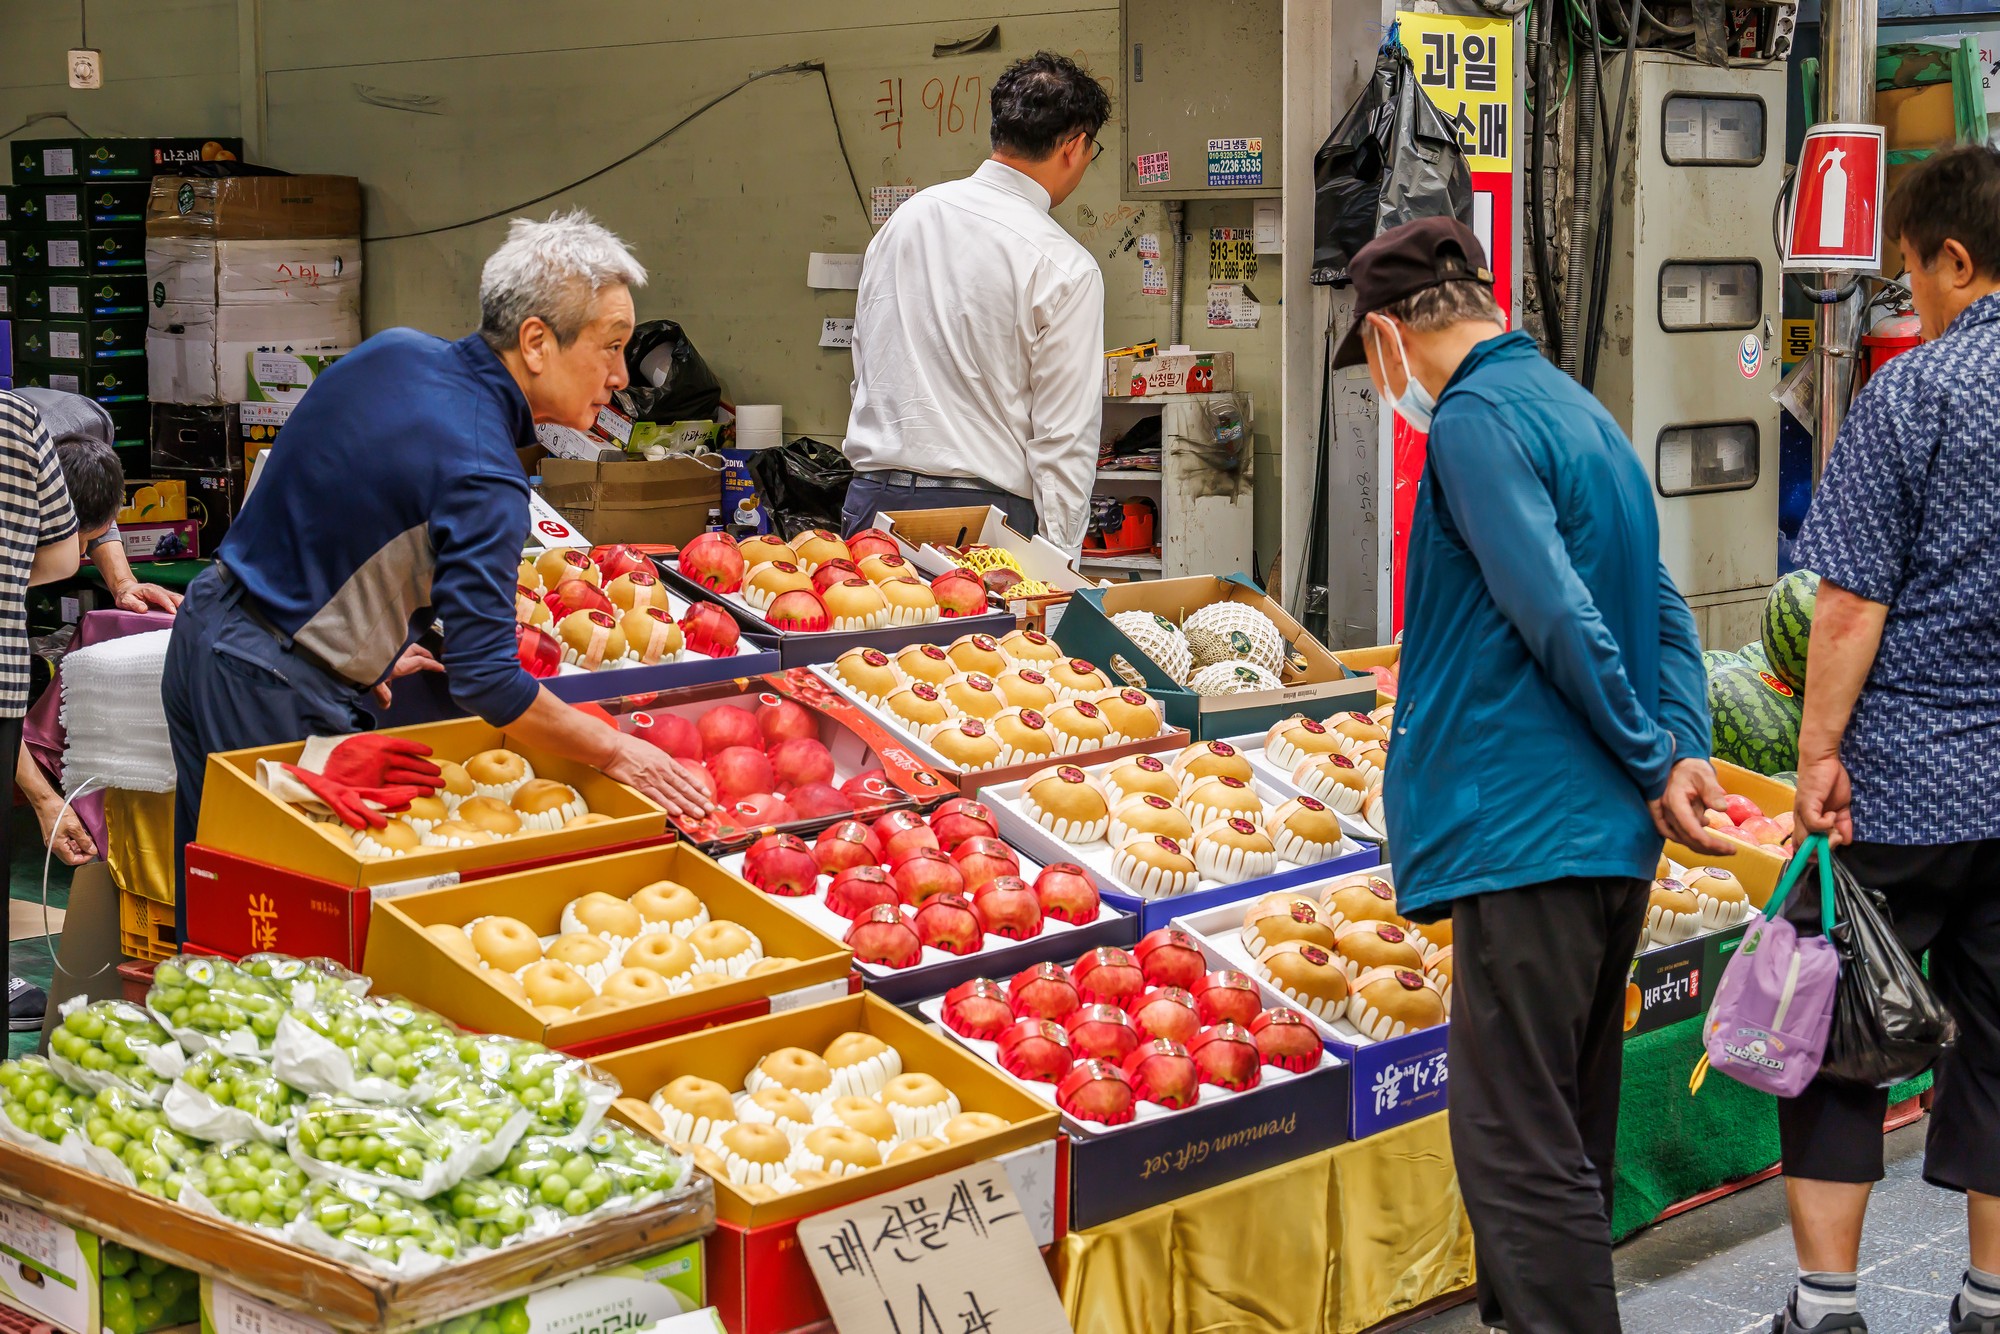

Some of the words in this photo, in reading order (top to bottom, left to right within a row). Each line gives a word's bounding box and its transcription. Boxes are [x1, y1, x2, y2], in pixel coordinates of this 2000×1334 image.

[1421, 33, 1497, 92] 과일
[874, 77, 903, 150] 퀵
[163, 149, 200, 165] 나주배
[1209, 140, 1231, 150] 유니크
[1232, 139, 1247, 150] 냉동
[1249, 140, 1261, 151] A/S
[1149, 372, 1184, 387] 산청딸기
[1643, 972, 1689, 1011] 나주배
[1212, 1111, 1297, 1152] Premium
[1140, 1153, 1169, 1180] Set
[1178, 1142, 1210, 1170] Gift
